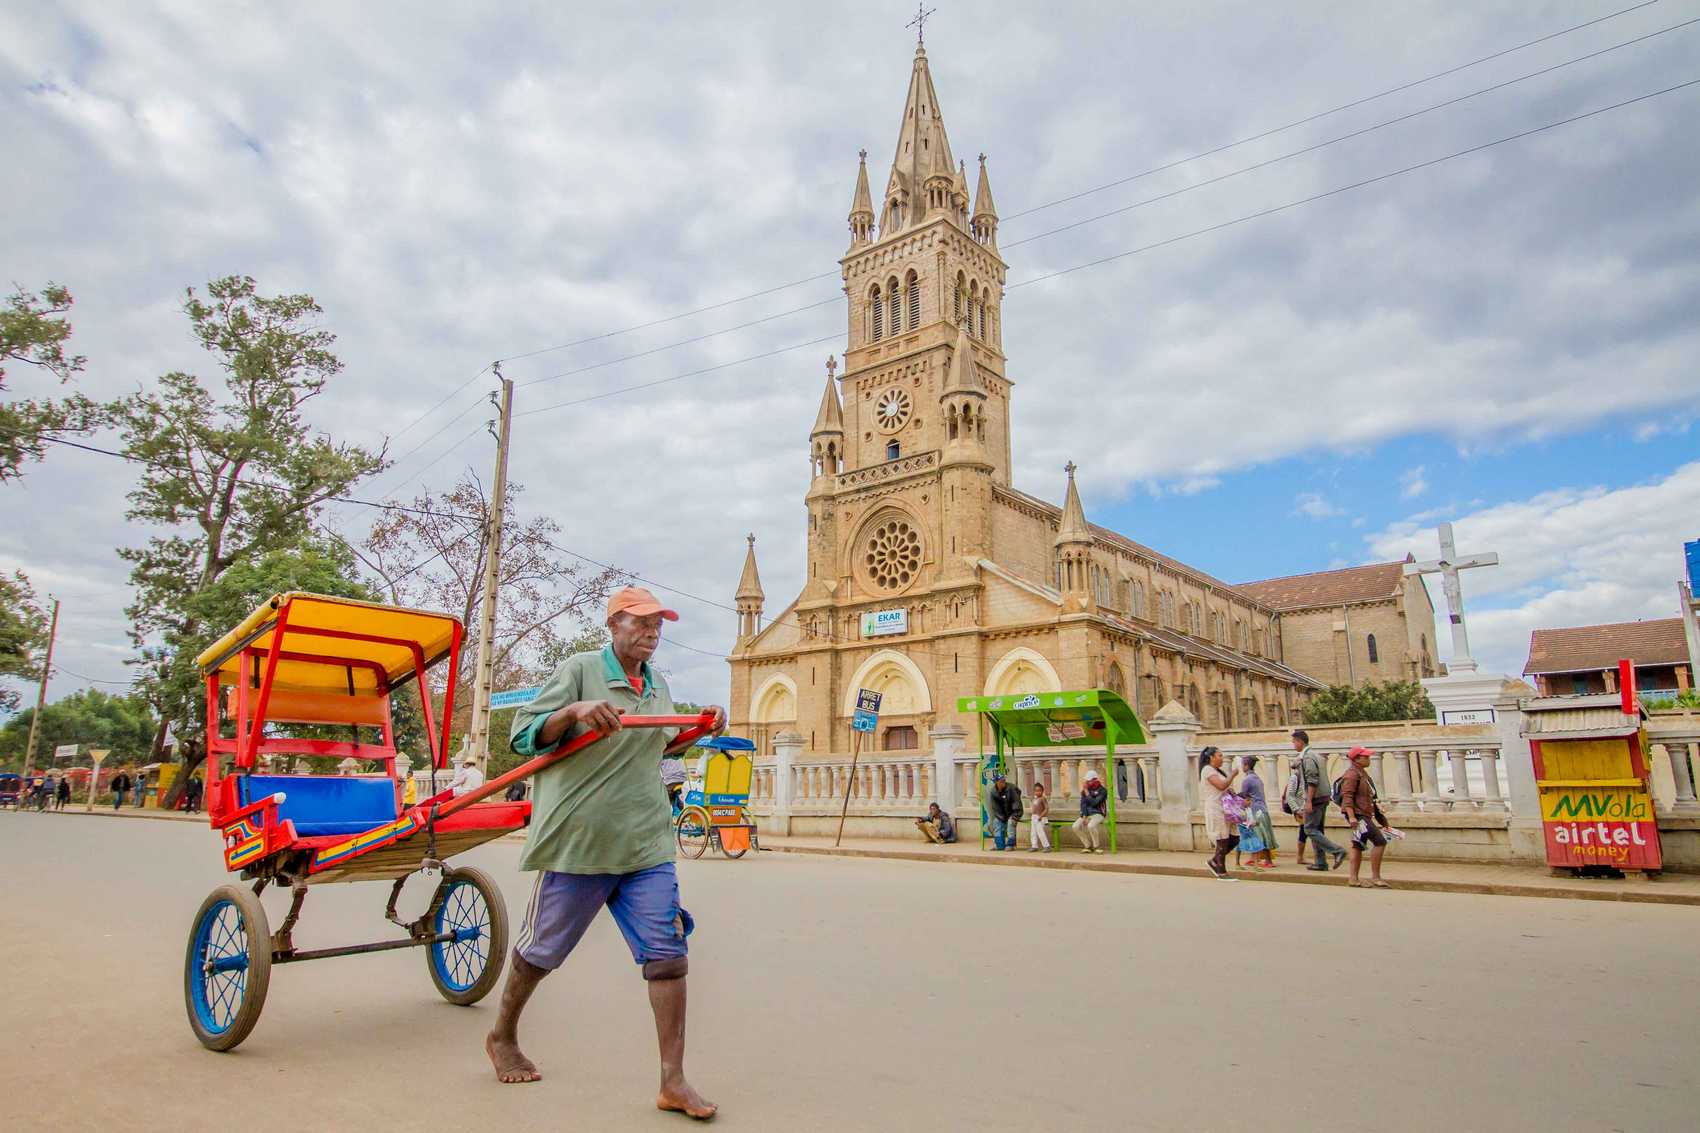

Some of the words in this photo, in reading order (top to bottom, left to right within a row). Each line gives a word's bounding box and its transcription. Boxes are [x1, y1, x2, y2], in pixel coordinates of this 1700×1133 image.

[878, 612, 901, 622] EKAR
[861, 699, 877, 711] BUS
[1550, 794, 1646, 818] MVola
[1554, 822, 1646, 846] airtel
[1573, 846, 1629, 862] money
